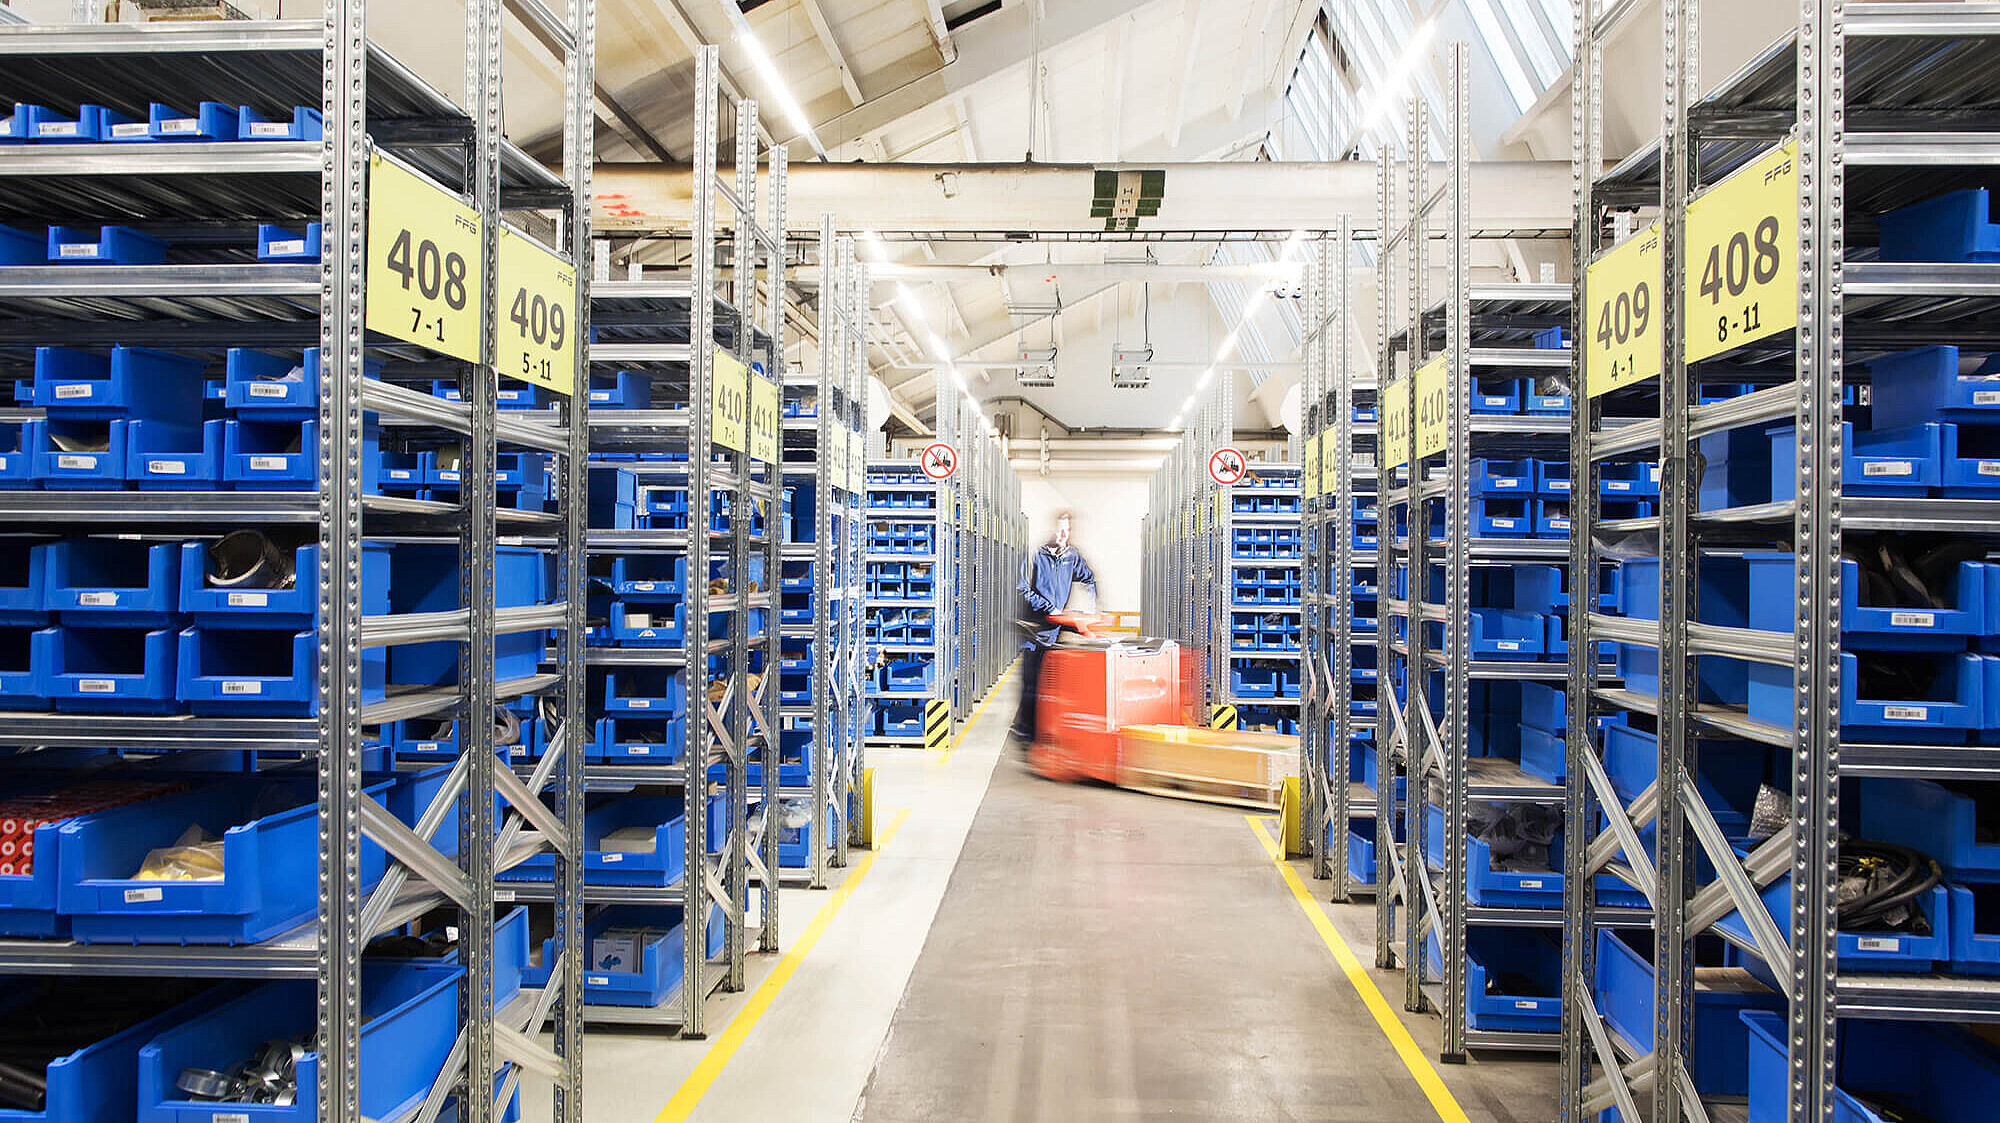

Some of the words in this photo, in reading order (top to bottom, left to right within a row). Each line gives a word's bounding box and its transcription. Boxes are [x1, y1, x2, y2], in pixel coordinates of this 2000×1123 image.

[1763, 159, 1792, 187] FFG
[387, 228, 467, 311] 408
[1700, 215, 1780, 306] 408
[510, 287, 565, 351] 409
[1597, 281, 1650, 352] 409
[718, 384, 742, 425] 410
[754, 404, 774, 440] 411
[1388, 406, 1406, 443] 411
[1421, 387, 1444, 429] 410
